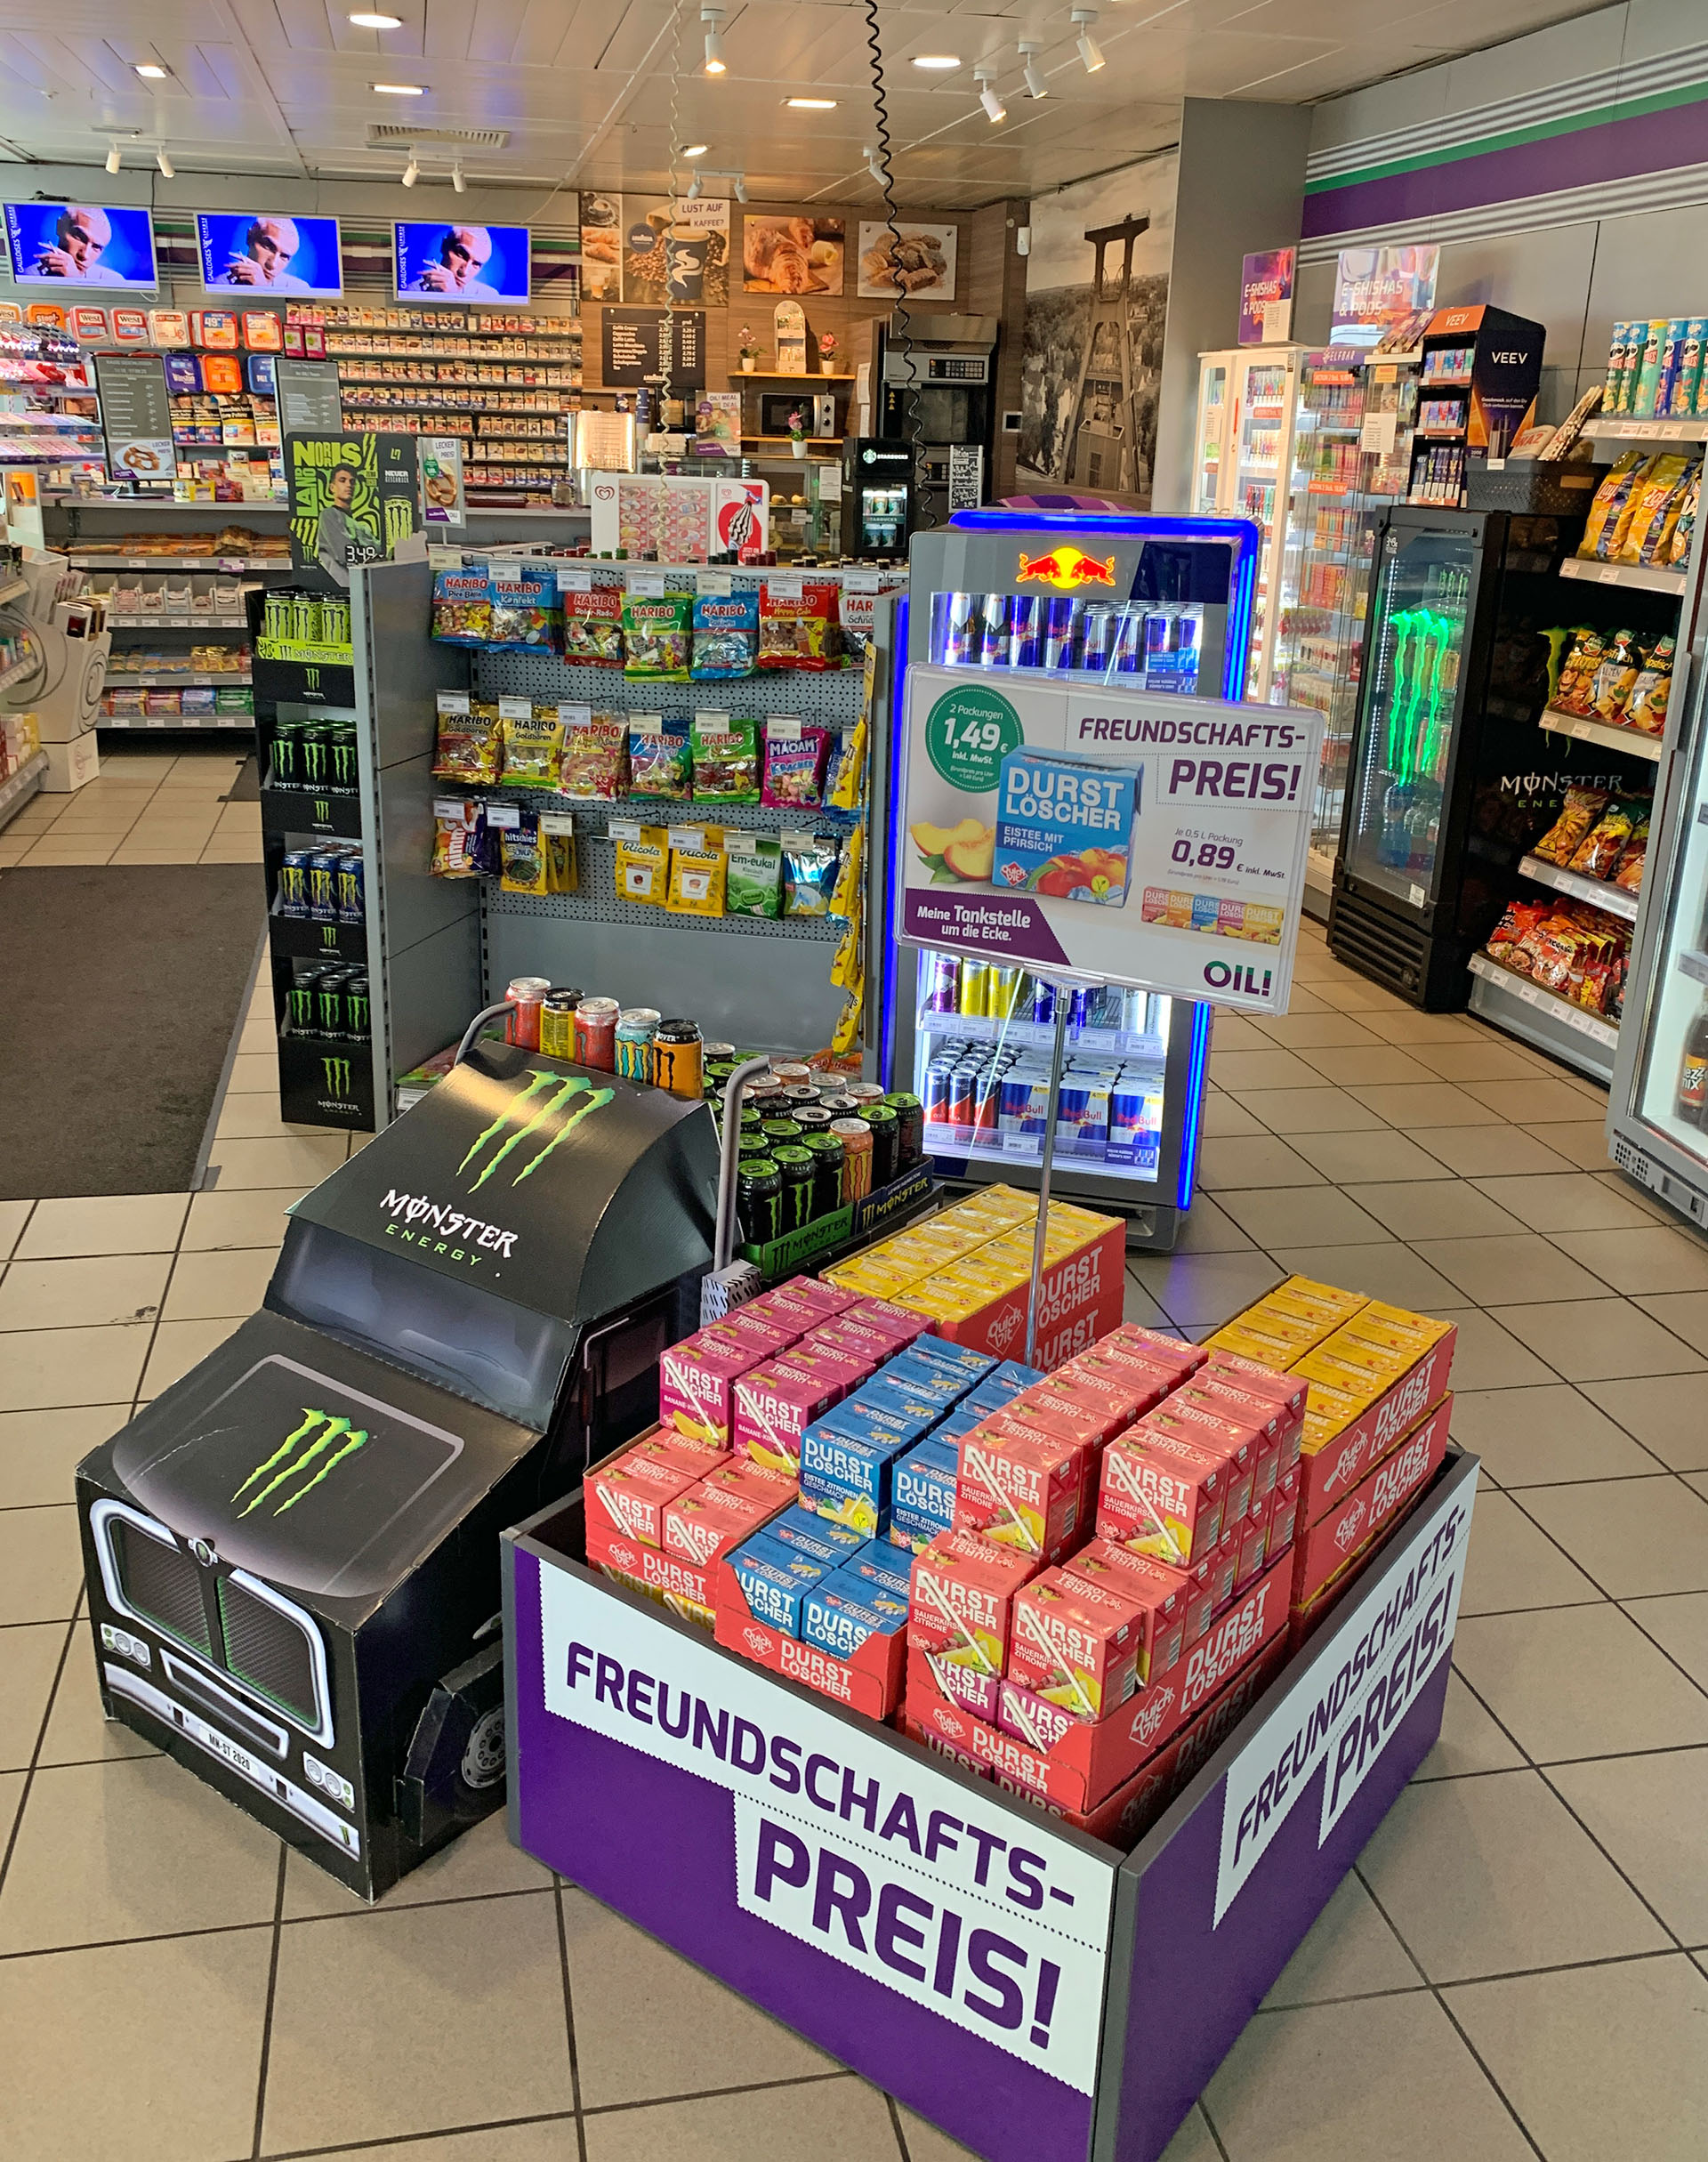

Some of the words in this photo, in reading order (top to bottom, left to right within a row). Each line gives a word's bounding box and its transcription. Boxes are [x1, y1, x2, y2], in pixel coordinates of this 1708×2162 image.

[681, 204, 704, 214] LUST
[706, 203, 724, 213] AUF
[694, 219, 724, 228] KAFFEE?
[13, 238, 24, 273] GAULOISES
[203, 249, 214, 282] GAULOISES
[399, 256, 407, 289] GAULOISES
[1244, 279, 1277, 298] E-SHISHAS
[1341, 279, 1404, 297] E-SHISHAS
[81, 313, 101, 323] West
[1249, 300, 1266, 315] PODS
[1339, 303, 1348, 318] &
[1349, 301, 1382, 317] PODS
[119, 313, 141, 324] West
[1445, 313, 1469, 327] VEEV
[1491, 351, 1528, 365] VEEV
[435, 440, 455, 449] LECKER
[446, 577, 487, 589] HARIBO
[496, 582, 541, 594] HARIBO
[500, 594, 536, 605] Konfekt
[574, 593, 617, 607] HARIBO
[769, 594, 817, 607] HARIBO
[846, 599, 874, 612] HAR
[632, 606, 675, 618] HARIBO
[701, 604, 745, 617] HARIBO
[447, 714, 491, 727] HARIBO
[949, 704, 957, 714] 2
[957, 705, 1003, 721] Packungen
[514, 719, 556, 732] HARIBO
[572, 724, 619, 738] HARIBO
[944, 717, 1001, 752] 1,49
[1000, 743, 1009, 753] €
[1078, 717, 1306, 748] FREUNDSCHAFTS-
[641, 734, 683, 748] HARIBO
[701, 731, 744, 746] HARIBO
[769, 740, 815, 757] MAOAM
[769, 759, 815, 776] KRACHER
[970, 754, 994, 764] MwSt.
[1006, 766, 1124, 810] DURST
[1168, 758, 1301, 801] PREIS!
[1005, 793, 1122, 831] LÖSCHER
[1517, 798, 1559, 809] ENE
[504, 831, 537, 844] hitschies
[1003, 835, 1053, 853] PFIRSICH
[1004, 826, 1042, 841] EISTEE
[1044, 832, 1064, 843] MIT
[1174, 827, 1184, 836] Je
[1185, 828, 1199, 839] 0,5
[1201, 831, 1206, 840] L
[1208, 832, 1244, 848] Packung
[623, 841, 662, 858] Ricola
[1171, 839, 1236, 870] 0,89
[1237, 863, 1244, 872] €
[1245, 866, 1261, 875] inkl.
[1262, 868, 1286, 880] MwSt.
[730, 852, 776, 870] Em-eukal
[917, 906, 951, 921] Meine
[954, 904, 1031, 928] Tankstelle
[941, 924, 960, 936] um
[962, 924, 979, 938] die
[981, 926, 1011, 941] Ecke.
[1204, 960, 1272, 997] OIL!
[317, 1100, 359, 1112] MONSTER
[1005, 1102, 1023, 1114] Red
[1026, 1104, 1043, 1115] Bull
[1063, 1109, 1081, 1120] Red
[1084, 1109, 1102, 1121] Bull
[1138, 1114, 1157, 1125] Bull
[876, 1175, 929, 1216] MONSTER
[379, 1189, 520, 1259] MONSTER
[793, 1216, 849, 1250] MONSTER
[385, 1223, 483, 1267] ENERGY
[1038, 1274, 1101, 1329] ÖSCHER
[1375, 1352, 1438, 1437] DURST
[1367, 1385, 1429, 1462] LÖSCHER
[804, 1438, 874, 1480] DURST
[1373, 1422, 1437, 1504] DURST
[803, 1453, 874, 1494] LÖSCHER
[802, 1479, 845, 1501] GESCHMACK
[803, 1472, 826, 1487] EISTEE
[826, 1480, 859, 1499] ZITRONEN
[897, 1472, 956, 1508] DURS
[1367, 1456, 1429, 1529] LÖSCHER
[896, 1489, 956, 1522] LÖSCHE
[960, 1490, 994, 1510] ZITRONE
[896, 1507, 919, 1523] EISTEE
[1102, 1502, 1138, 1521] ZITRONE
[643, 1552, 706, 1592] DURST
[643, 1568, 707, 1606] LÖSCHER
[740, 1572, 795, 1612] URST
[913, 1615, 947, 1634] ZITRONE
[1184, 1580, 1271, 1683] DURST
[806, 1622, 867, 1656] LÖSCH
[780, 1640, 853, 1685] DURST
[1013, 1650, 1048, 1671] ZITRONE
[1180, 1617, 1265, 1715] LÖSCHER
[779, 1658, 852, 1701] LÖSCHER
[934, 1654, 992, 1696] URST
[1233, 1504, 1467, 1870] FREUNDSCHAFTS-
[1328, 1571, 1455, 1819] PREIS!
[232, 1750, 251, 1771] 2020
[972, 1725, 1051, 1780] DURST
[567, 1641, 1076, 1911] FREUNDSCHAFTS-
[972, 1741, 1048, 1795] LÖSCHER
[753, 1818, 1062, 2050] PREIS!
